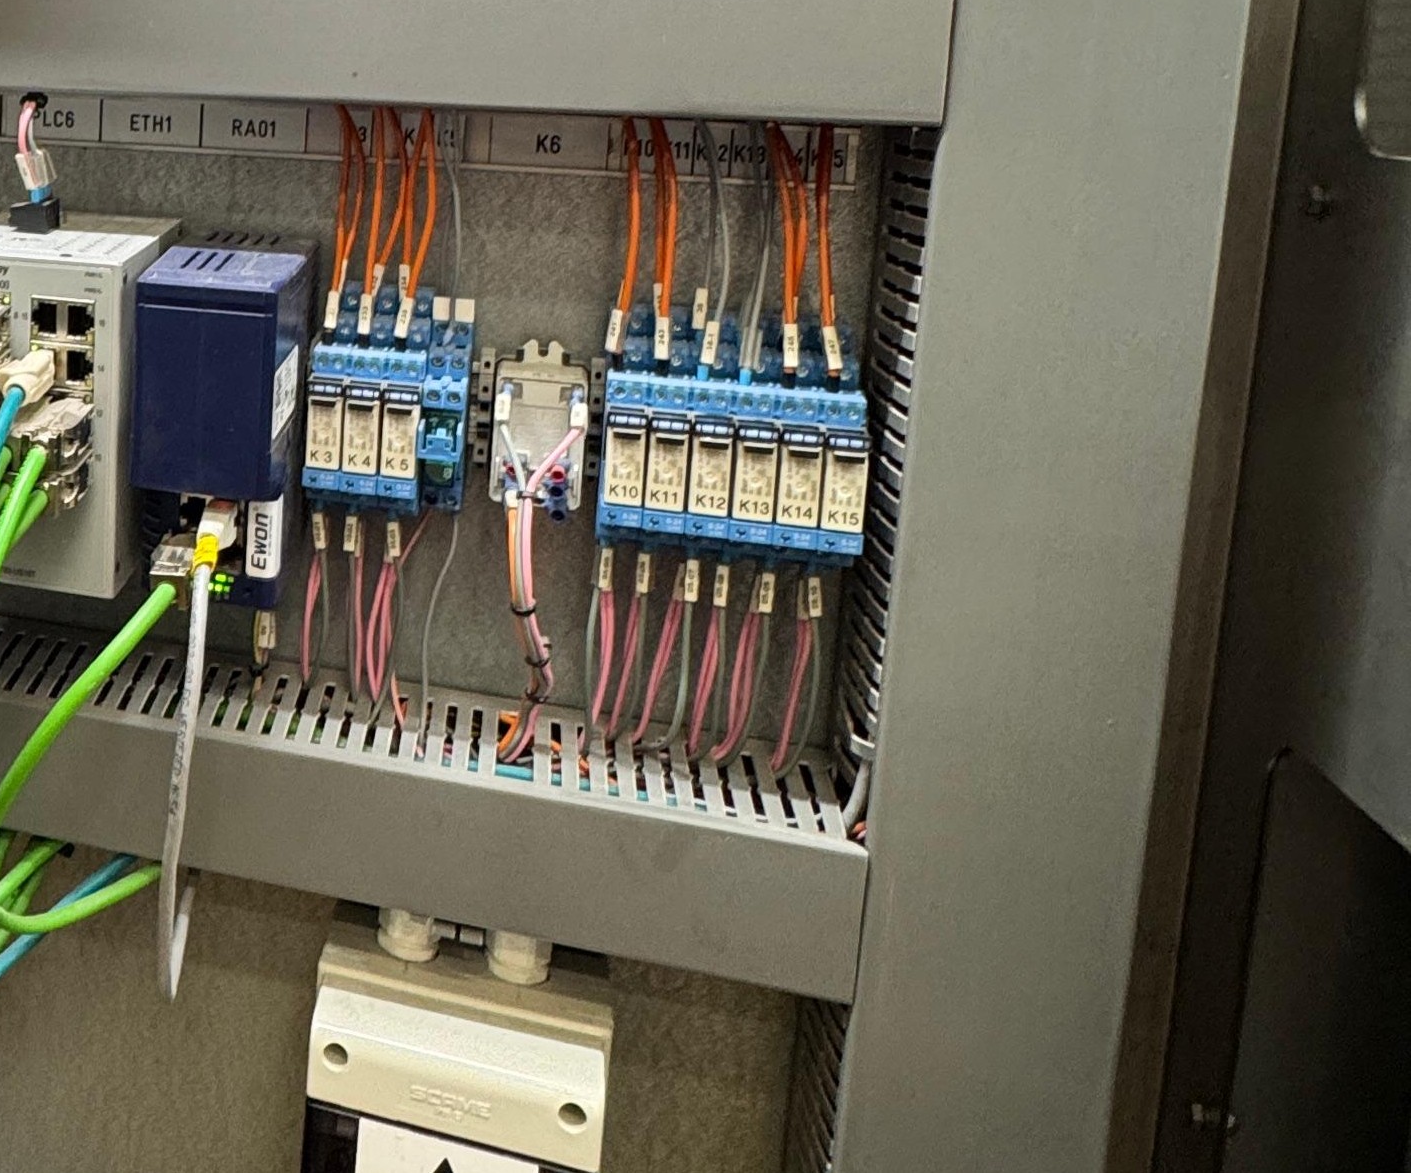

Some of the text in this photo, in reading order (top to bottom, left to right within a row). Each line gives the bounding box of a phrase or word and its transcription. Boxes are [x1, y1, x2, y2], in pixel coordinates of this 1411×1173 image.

[33, 110, 76, 129] PLC6
[129, 113, 173, 134] ETH1
[231, 118, 277, 139] RA01
[535, 134, 562, 154] K6
[696, 142, 728, 163] K2
[310, 450, 332, 464] K 3
[348, 454, 372, 467] K 4
[385, 458, 409, 471] K 5
[609, 485, 639, 499] K10
[649, 490, 679, 503] K11
[695, 494, 727, 510] K12
[739, 500, 770, 516] K13
[781, 504, 813, 520] K14
[826, 509, 859, 526] K15
[250, 512, 269, 570] Ewon
